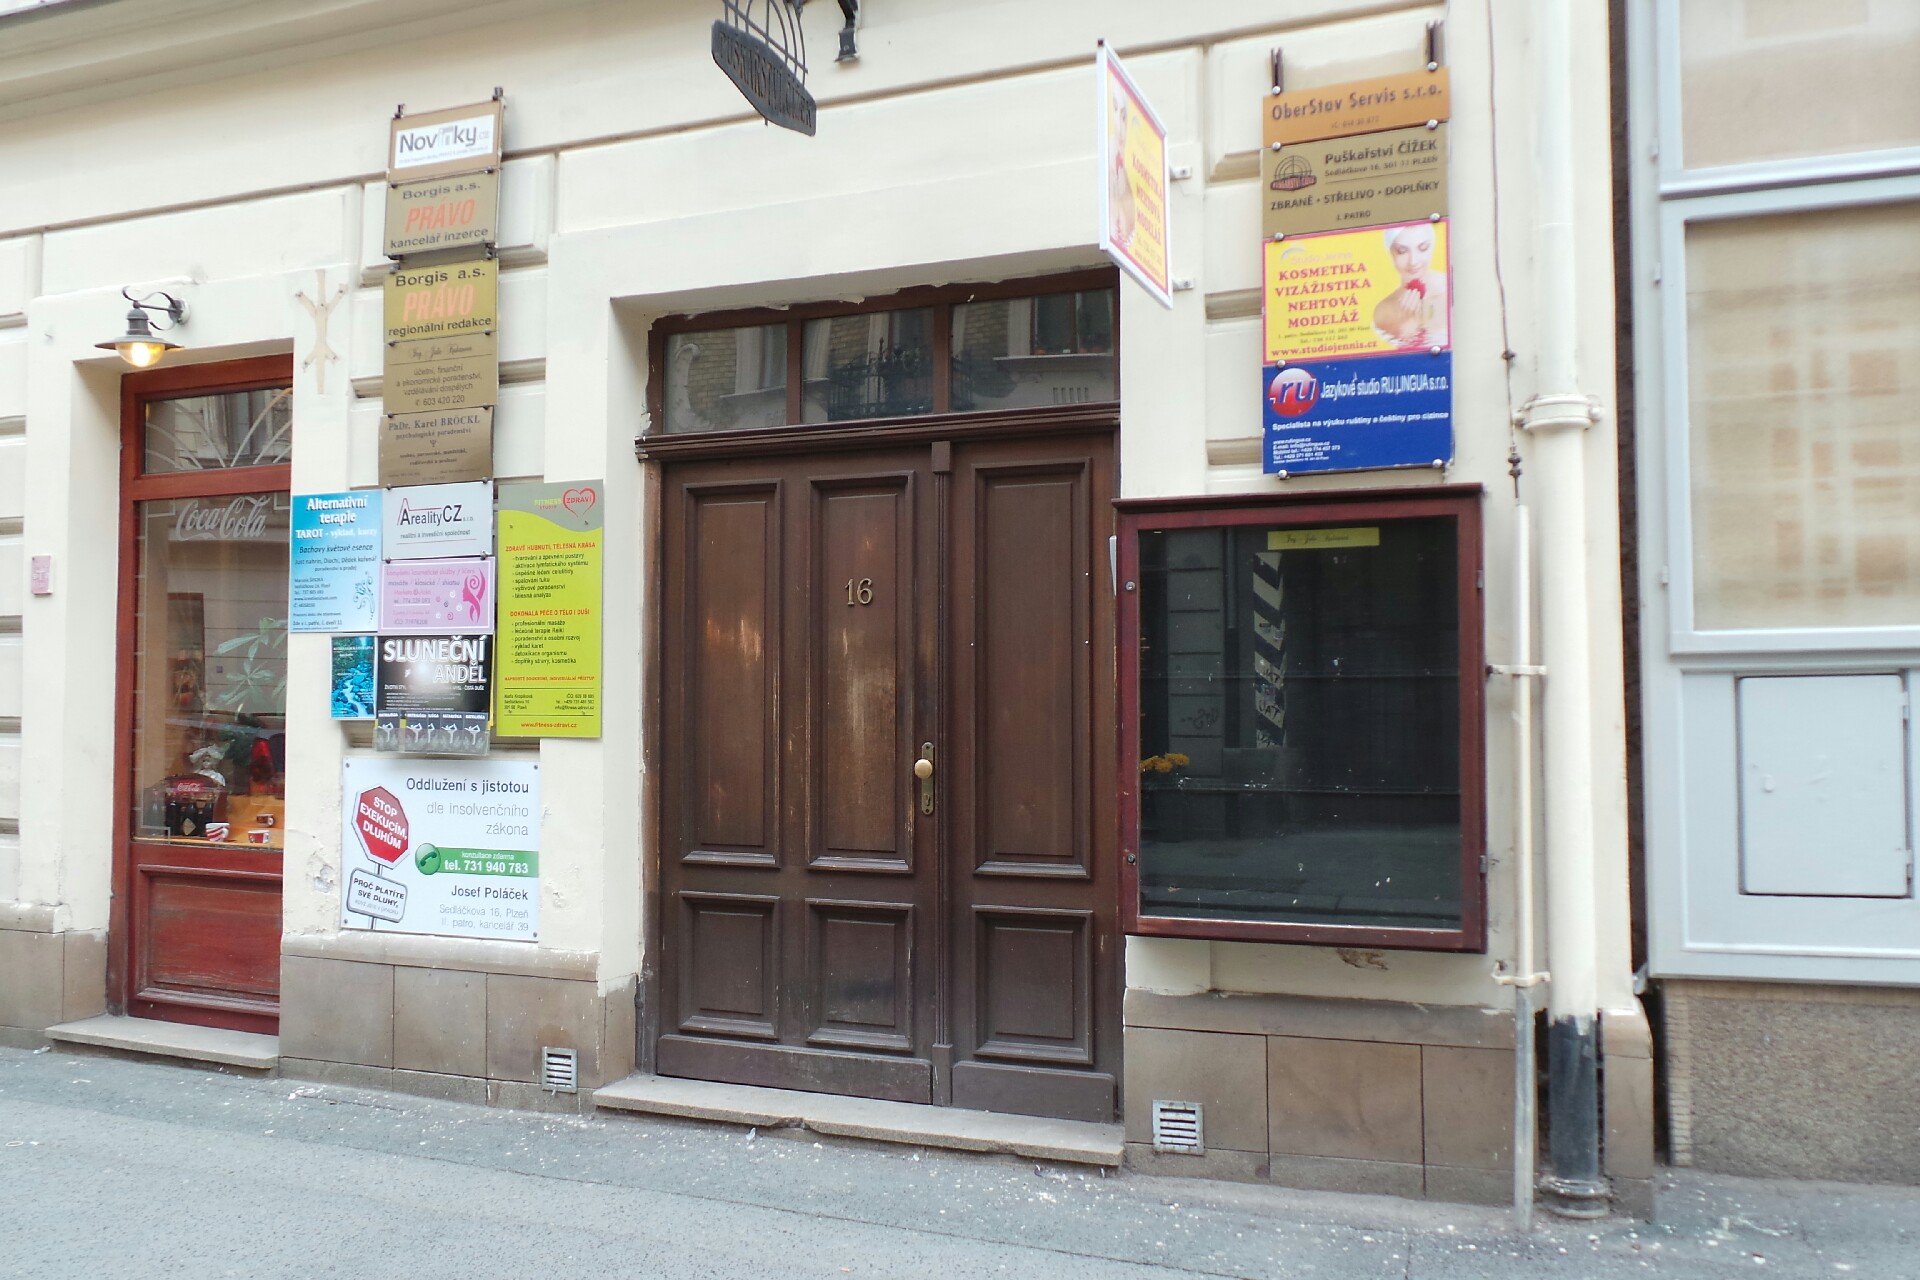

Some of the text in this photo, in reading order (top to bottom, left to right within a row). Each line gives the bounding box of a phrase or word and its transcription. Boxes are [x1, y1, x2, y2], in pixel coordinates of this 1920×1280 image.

[1272, 84, 1442, 120] OberStav Servis s.r.o.
[1326, 139, 1438, 164] Puškařství ČÍŽEK
[403, 182, 480, 199] Borgis a.s.
[1324, 188, 1374, 203] STŘELIVO
[1386, 180, 1440, 196] DOPLŇKY
[405, 195, 475, 233] PRÁVO
[1344, 210, 1371, 220] PATRO
[391, 228, 488, 249] kancelář inzerce
[396, 267, 485, 287] Borgis a.s.
[1279, 262, 1366, 280] KOSMETIKA
[1276, 278, 1371, 297] VIZÁŽISTIKA
[402, 282, 474, 322] PRÁVO
[1288, 294, 1358, 312] NEHTOVÁ
[389, 317, 492, 338] regionální redakce
[1288, 310, 1359, 328] MODELÁŽ
[1272, 340, 1377, 356] www.studiojennis.cz
[440, 383, 473, 392] dospělých
[1321, 380, 1356, 401] Jazykové
[1357, 378, 1380, 395] studio
[1429, 376, 1448, 390] s.r.o.
[423, 397, 436, 405] 603
[452, 395, 465, 403] 220
[389, 422, 410, 431] PhDr.
[415, 420, 437, 428] Karel
[1272, 421, 1311, 431] Specialista
[1323, 418, 1344, 427] výuku
[1346, 416, 1371, 426] ruštiny
[1407, 414, 1420, 422] pro
[307, 495, 368, 511] Alternativní
[566, 496, 591, 504] ZDRAVÍ
[320, 510, 356, 526] terapie
[295, 529, 323, 539] TAROT
[844, 577, 873, 605] 16
[383, 634, 487, 662] SLUNEČNÍ
[434, 660, 487, 683] ANDĚL
[406, 778, 529, 795] Oddlužení s jistotou
[373, 797, 397, 817] STOP
[427, 802, 528, 817] dle insolvenčního
[360, 803, 407, 840] EXEKUCÍM,
[486, 822, 528, 836] zákona
[363, 821, 401, 849] DLUHŮM
[444, 860, 528, 874] tel. 731 940 783
[354, 878, 404, 900] PROČ PLATÍTE
[451, 885, 528, 900] Josef Poláček
[358, 890, 371, 899] SVÉ
[373, 894, 398, 908] DLUHY,
[439, 904, 528, 919] Sedláčkova 16, Plzeň
[453, 918, 476, 929] patro,
[479, 919, 514, 930] kancelář
[518, 922, 528, 931] 39
